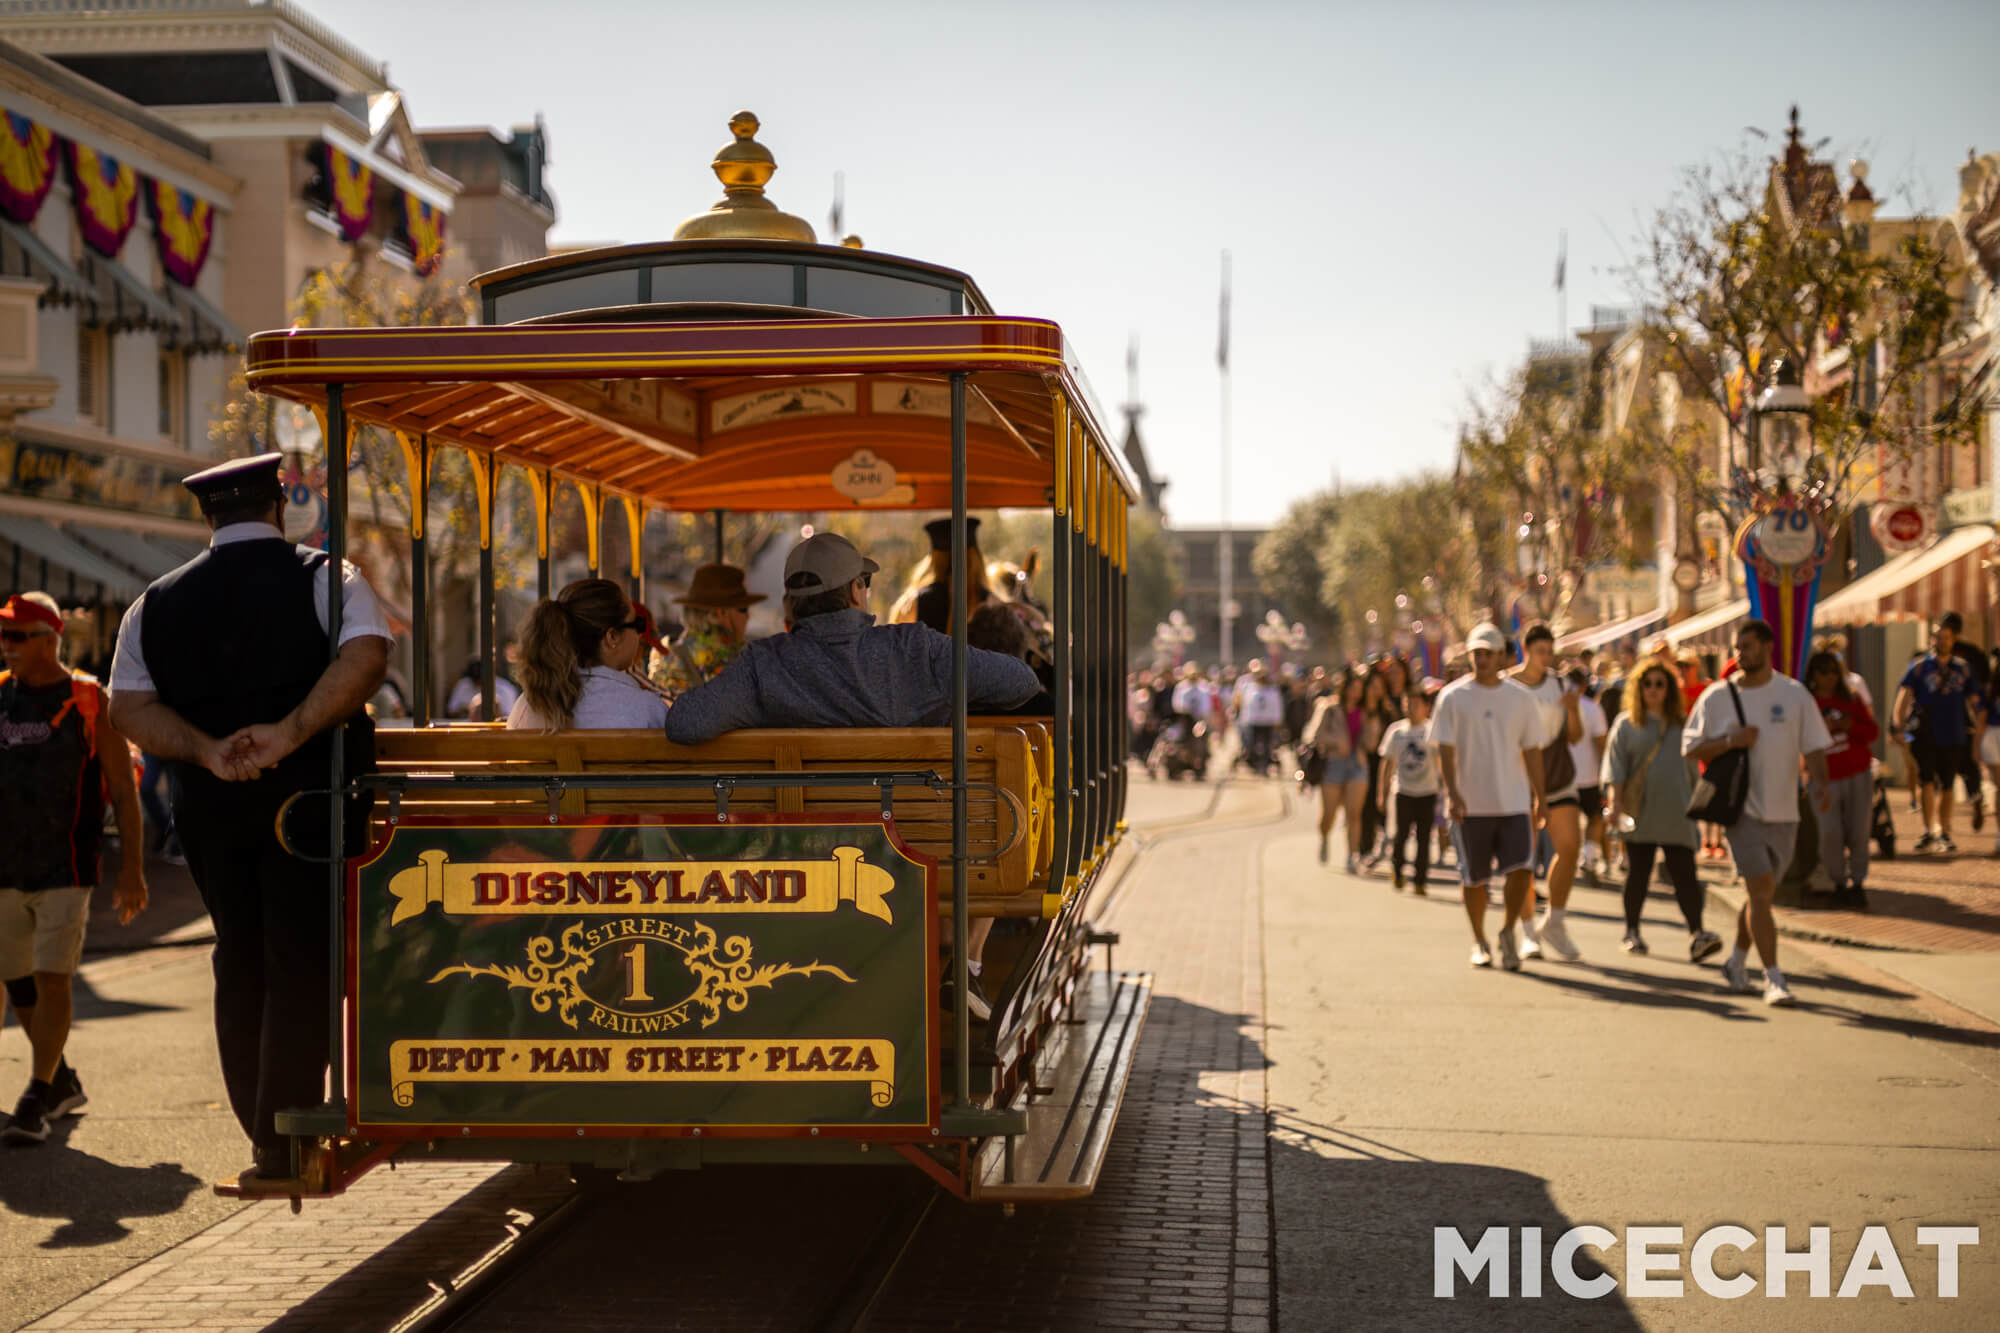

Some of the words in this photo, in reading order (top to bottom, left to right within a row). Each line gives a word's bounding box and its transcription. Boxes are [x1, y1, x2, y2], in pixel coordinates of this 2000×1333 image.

[1771, 508, 1809, 532] 70
[472, 869, 807, 905] DISNEYLAND
[586, 918, 691, 946] STREET
[622, 943, 654, 1001] 1
[588, 1004, 691, 1034] RAILWAY
[408, 1047, 504, 1073] DEPOT
[528, 1047, 612, 1072] MAIN
[625, 1046, 745, 1072] STREET
[764, 1046, 880, 1072] PLAZA
